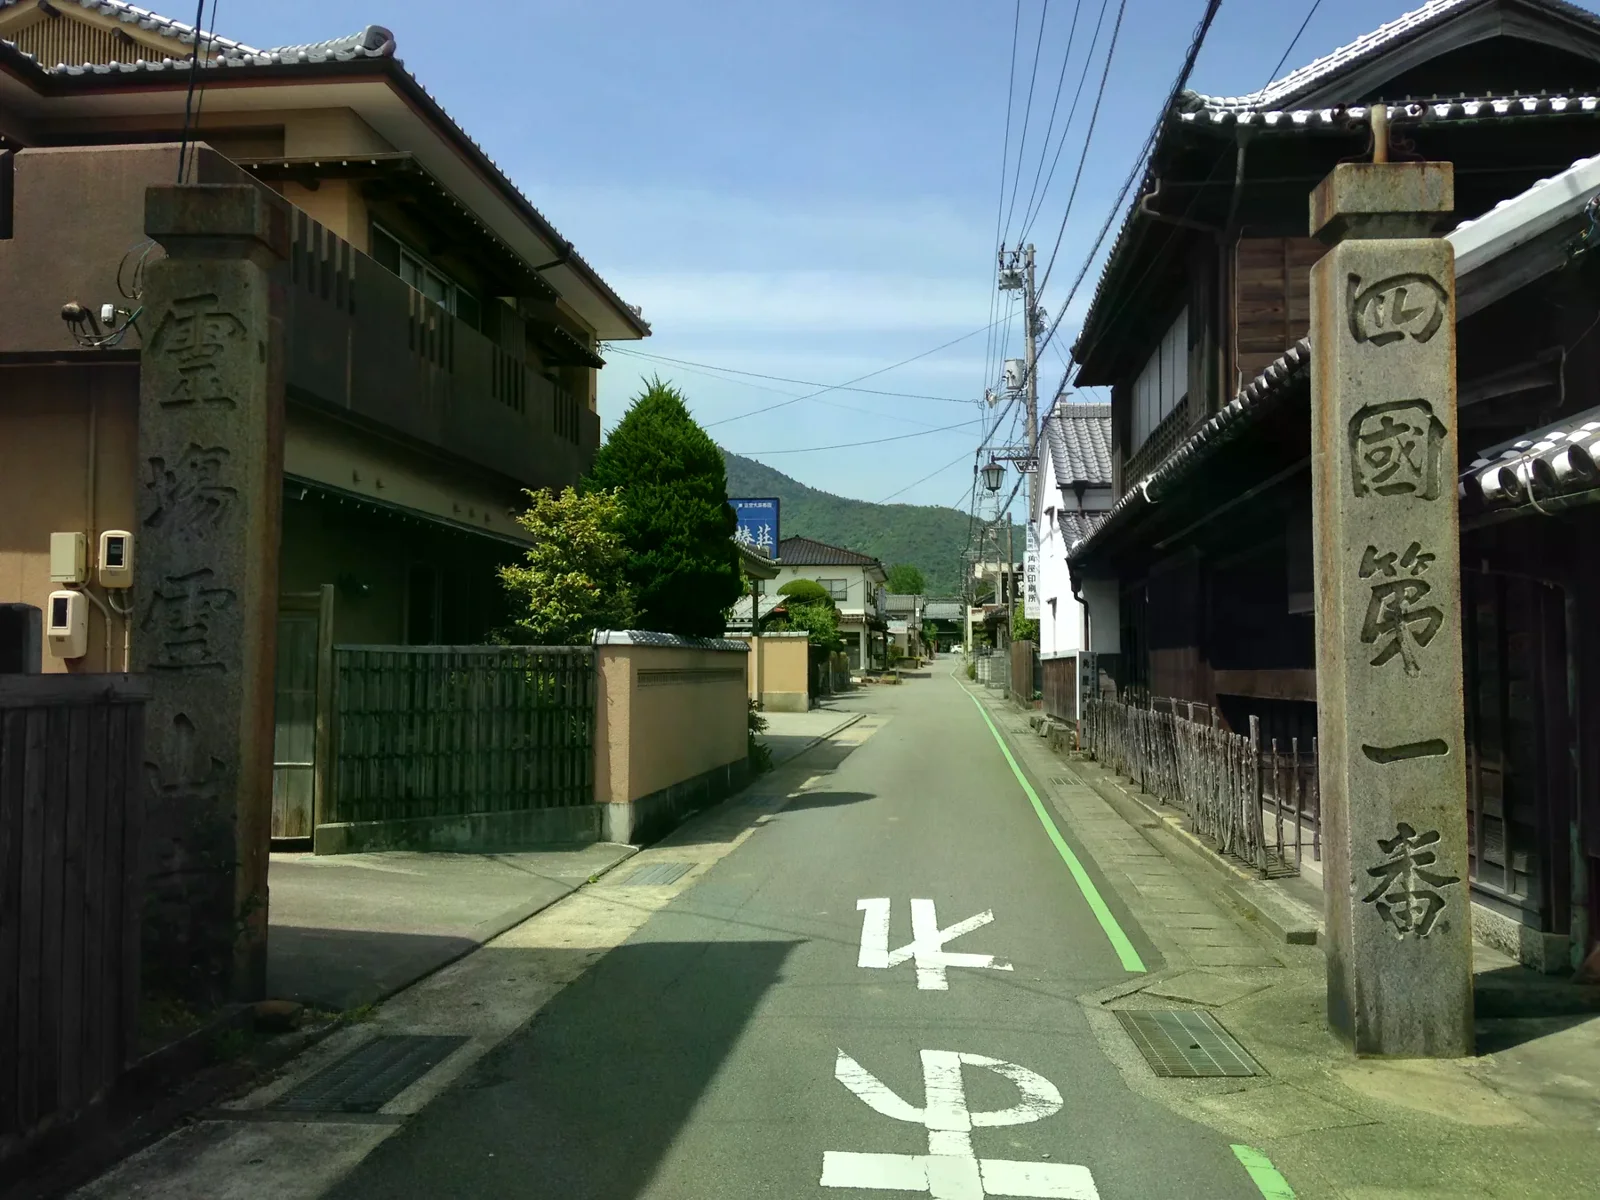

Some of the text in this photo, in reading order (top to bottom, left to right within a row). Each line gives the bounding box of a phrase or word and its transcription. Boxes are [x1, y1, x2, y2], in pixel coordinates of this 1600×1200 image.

[1027, 555, 1038, 603] 角屋印刷所
